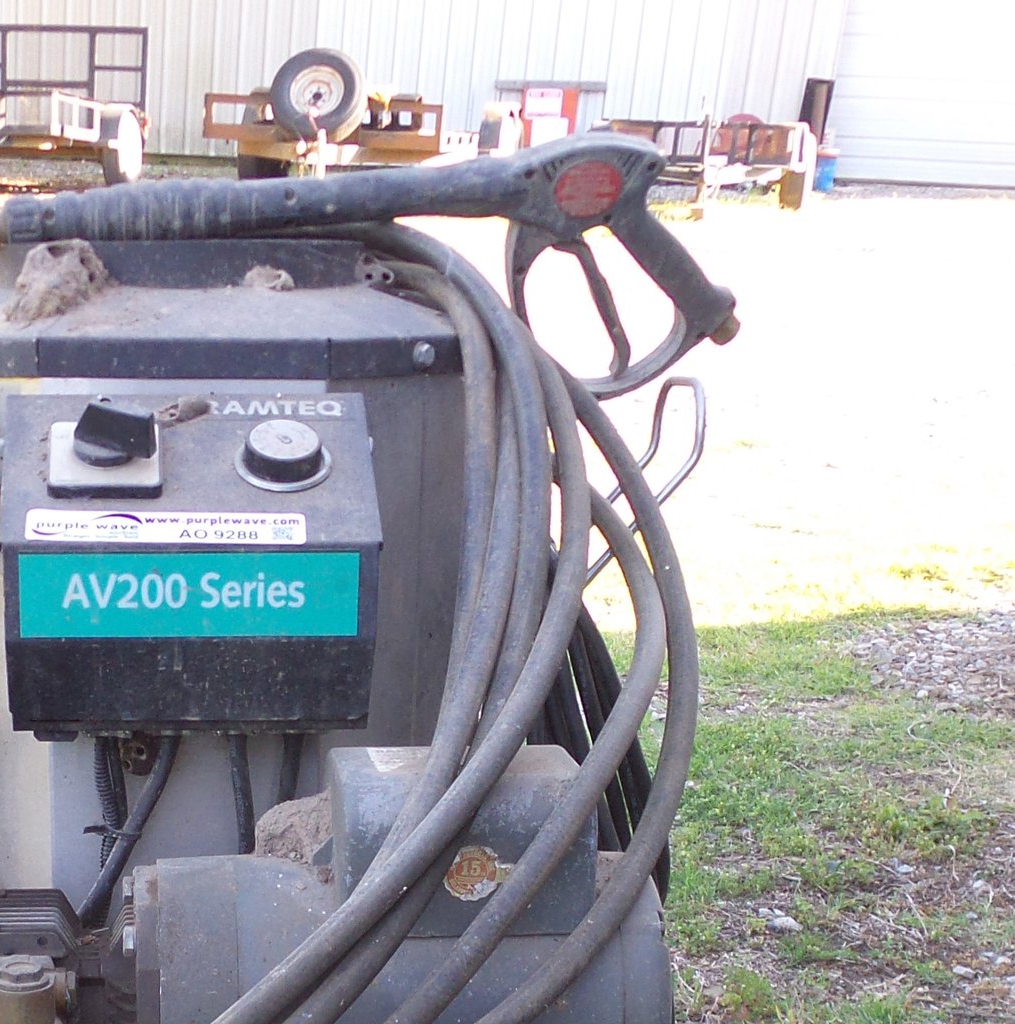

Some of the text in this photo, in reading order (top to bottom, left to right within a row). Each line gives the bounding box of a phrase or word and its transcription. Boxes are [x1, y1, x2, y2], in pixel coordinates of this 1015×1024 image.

[36, 522, 89, 530] purple
[144, 516, 300, 526] www.purplewave.com
[214, 530, 258, 540] 9288
[61, 573, 305, 609] AV200 Series
